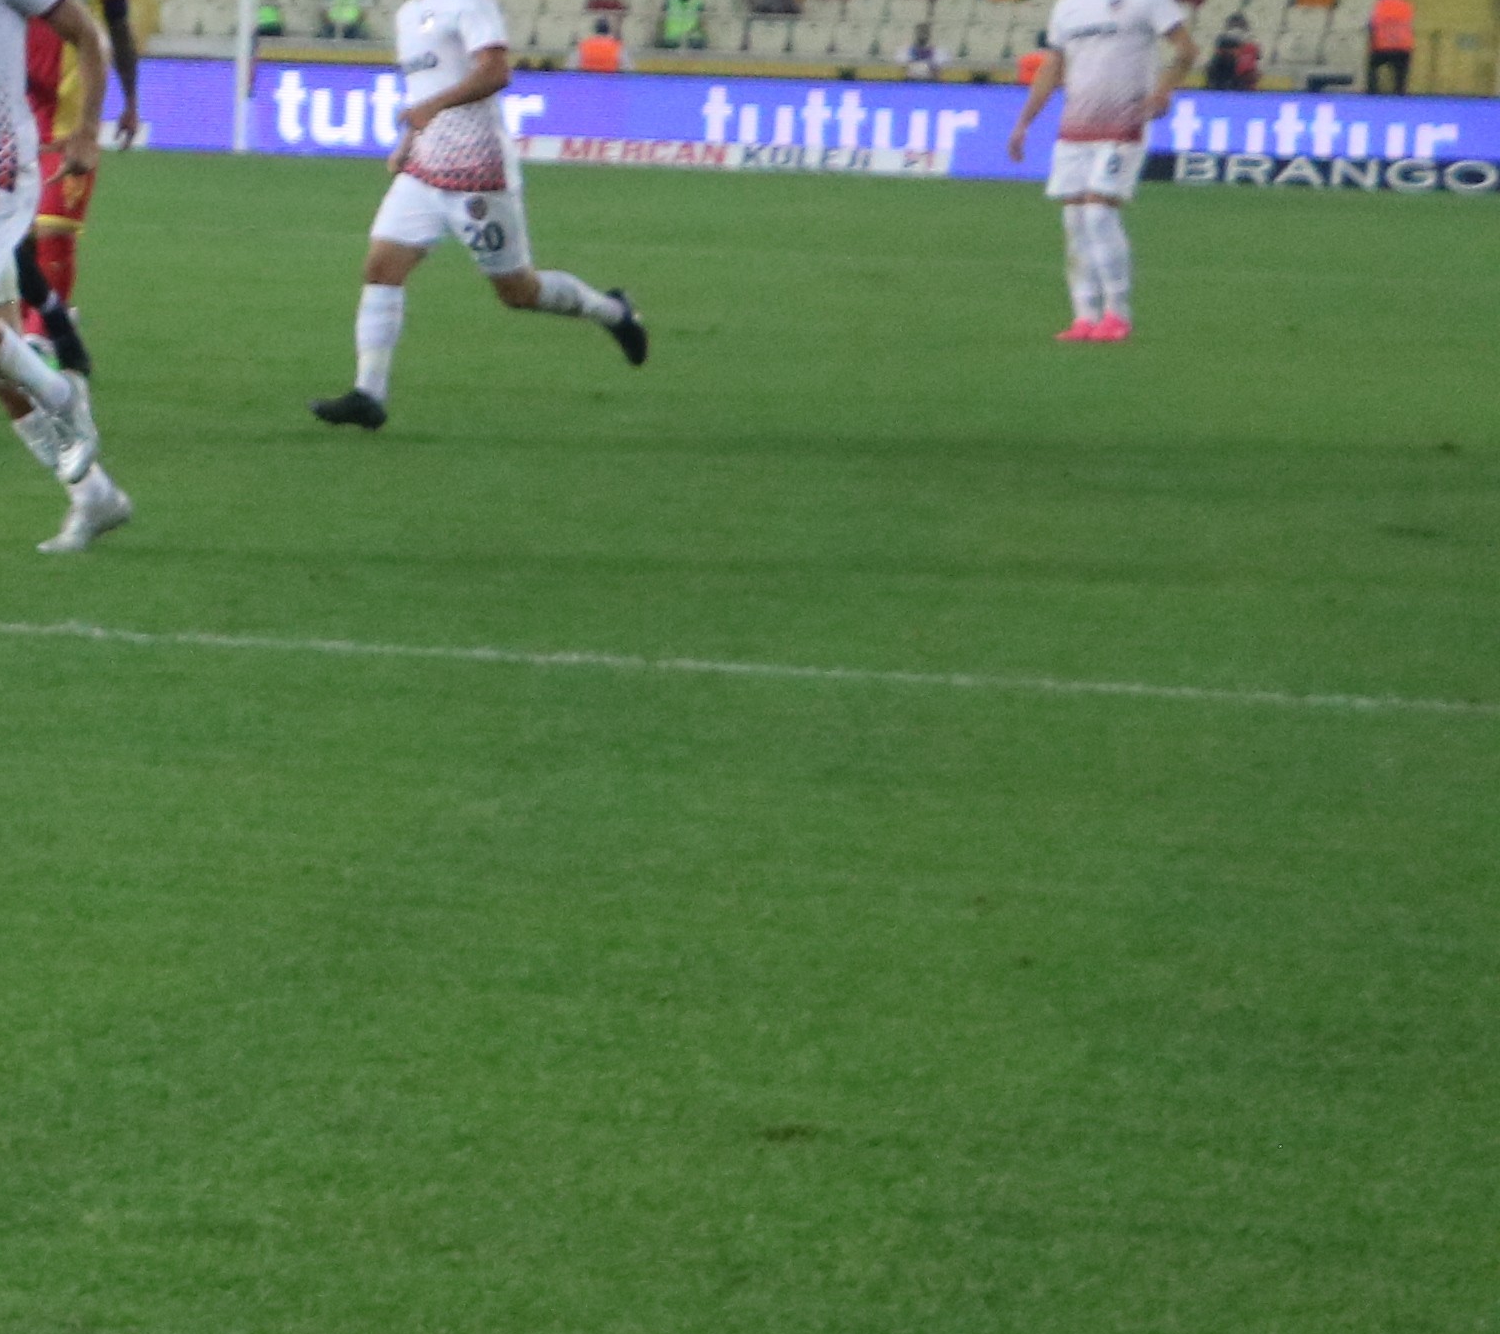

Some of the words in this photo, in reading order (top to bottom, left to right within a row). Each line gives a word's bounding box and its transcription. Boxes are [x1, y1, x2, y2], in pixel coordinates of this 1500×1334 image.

[274, 70, 545, 145] tutr
[702, 85, 978, 151] tuttur
[1171, 98, 1458, 158] tuttur
[1173, 154, 1499, 194] BRANGO
[463, 220, 505, 252] 20
